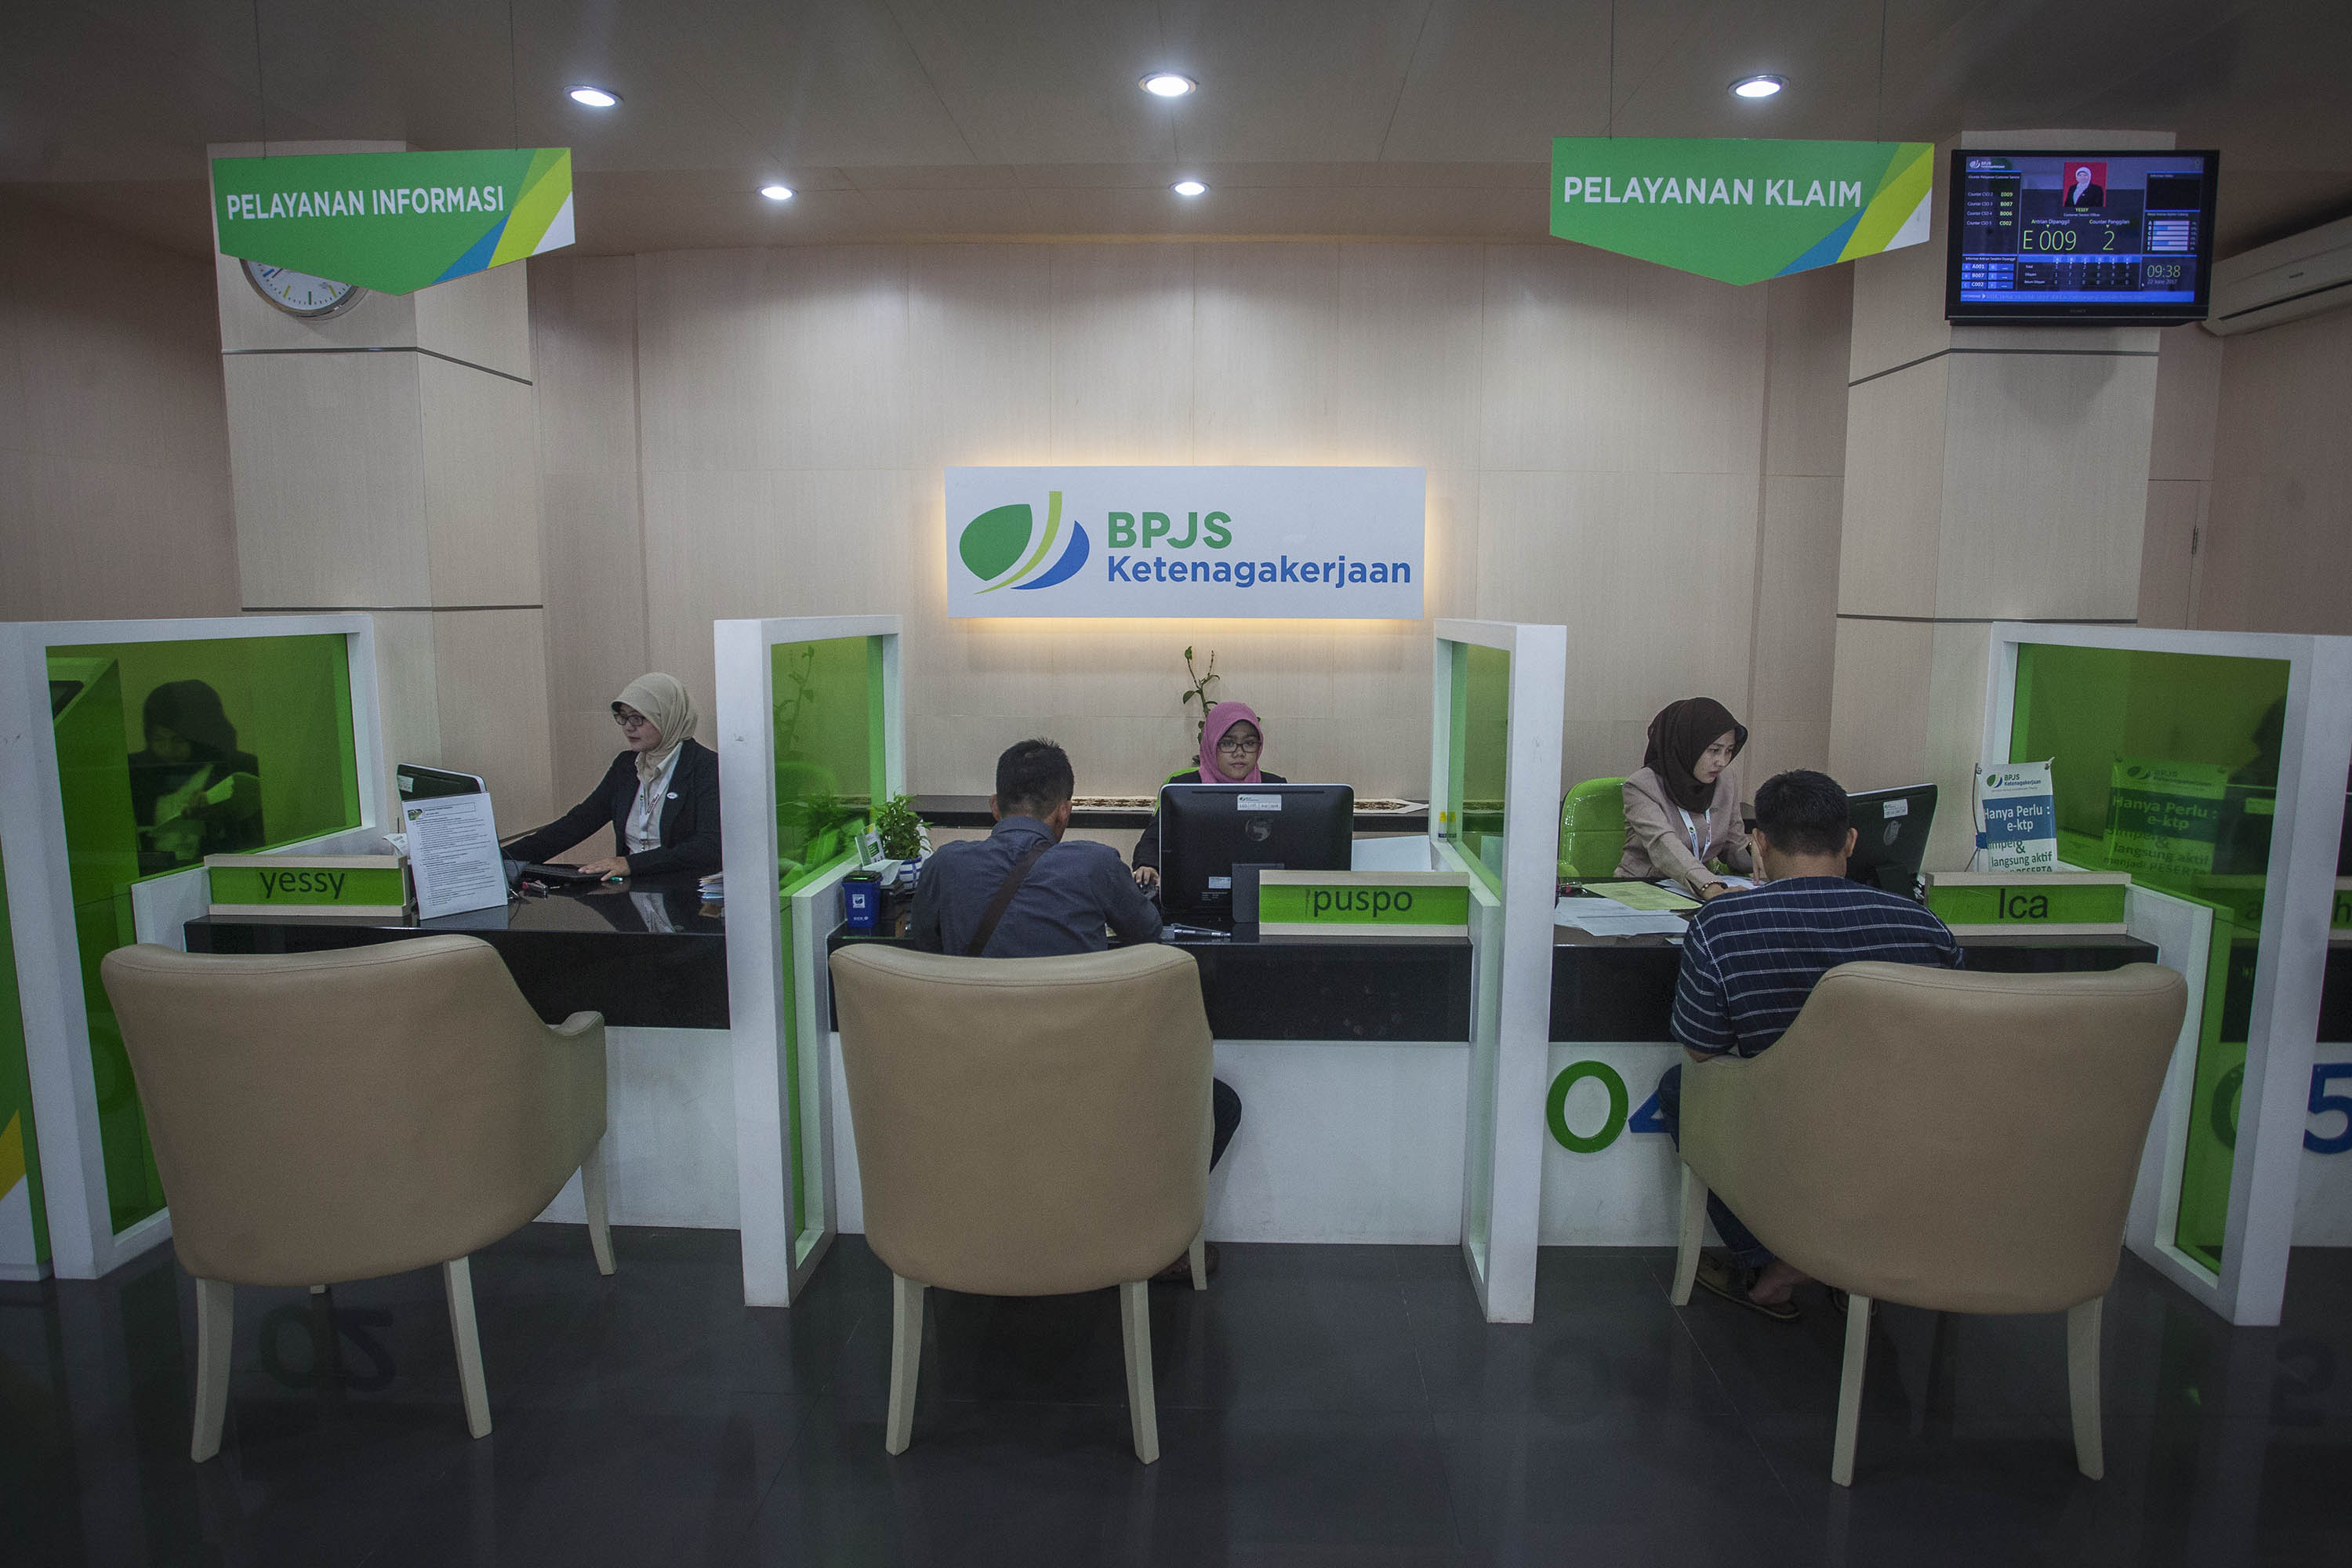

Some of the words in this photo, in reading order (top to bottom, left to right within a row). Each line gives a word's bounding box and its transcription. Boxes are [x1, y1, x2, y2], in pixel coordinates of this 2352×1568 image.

[1563, 176, 1754, 205] PELAYANAN
[1766, 179, 1862, 207] KLAIM
[227, 190, 365, 220] PELAYANAN
[372, 186, 504, 215] INFORMASI
[2024, 230, 2033, 249] E
[2039, 230, 2076, 251] 009
[2103, 230, 2114, 250] 2
[2147, 264, 2180, 278] 09:38
[1108, 511, 1232, 549] BPJS
[1108, 554, 1411, 589] Ketenagakerjaan
[1985, 808, 2013, 821] Hanya
[2016, 804, 2042, 817] Perlu
[2113, 795, 2161, 813] Hanya
[2165, 802, 2208, 817] Perlu
[2007, 818, 2034, 833] e-ktp
[2147, 813, 2190, 831] e-ktp
[2016, 840, 2026, 854] &
[1991, 855, 2030, 868] langsung
[2031, 851, 2053, 862] aktif
[260, 872, 345, 900] yessy
[1314, 890, 1412, 918] puspo
